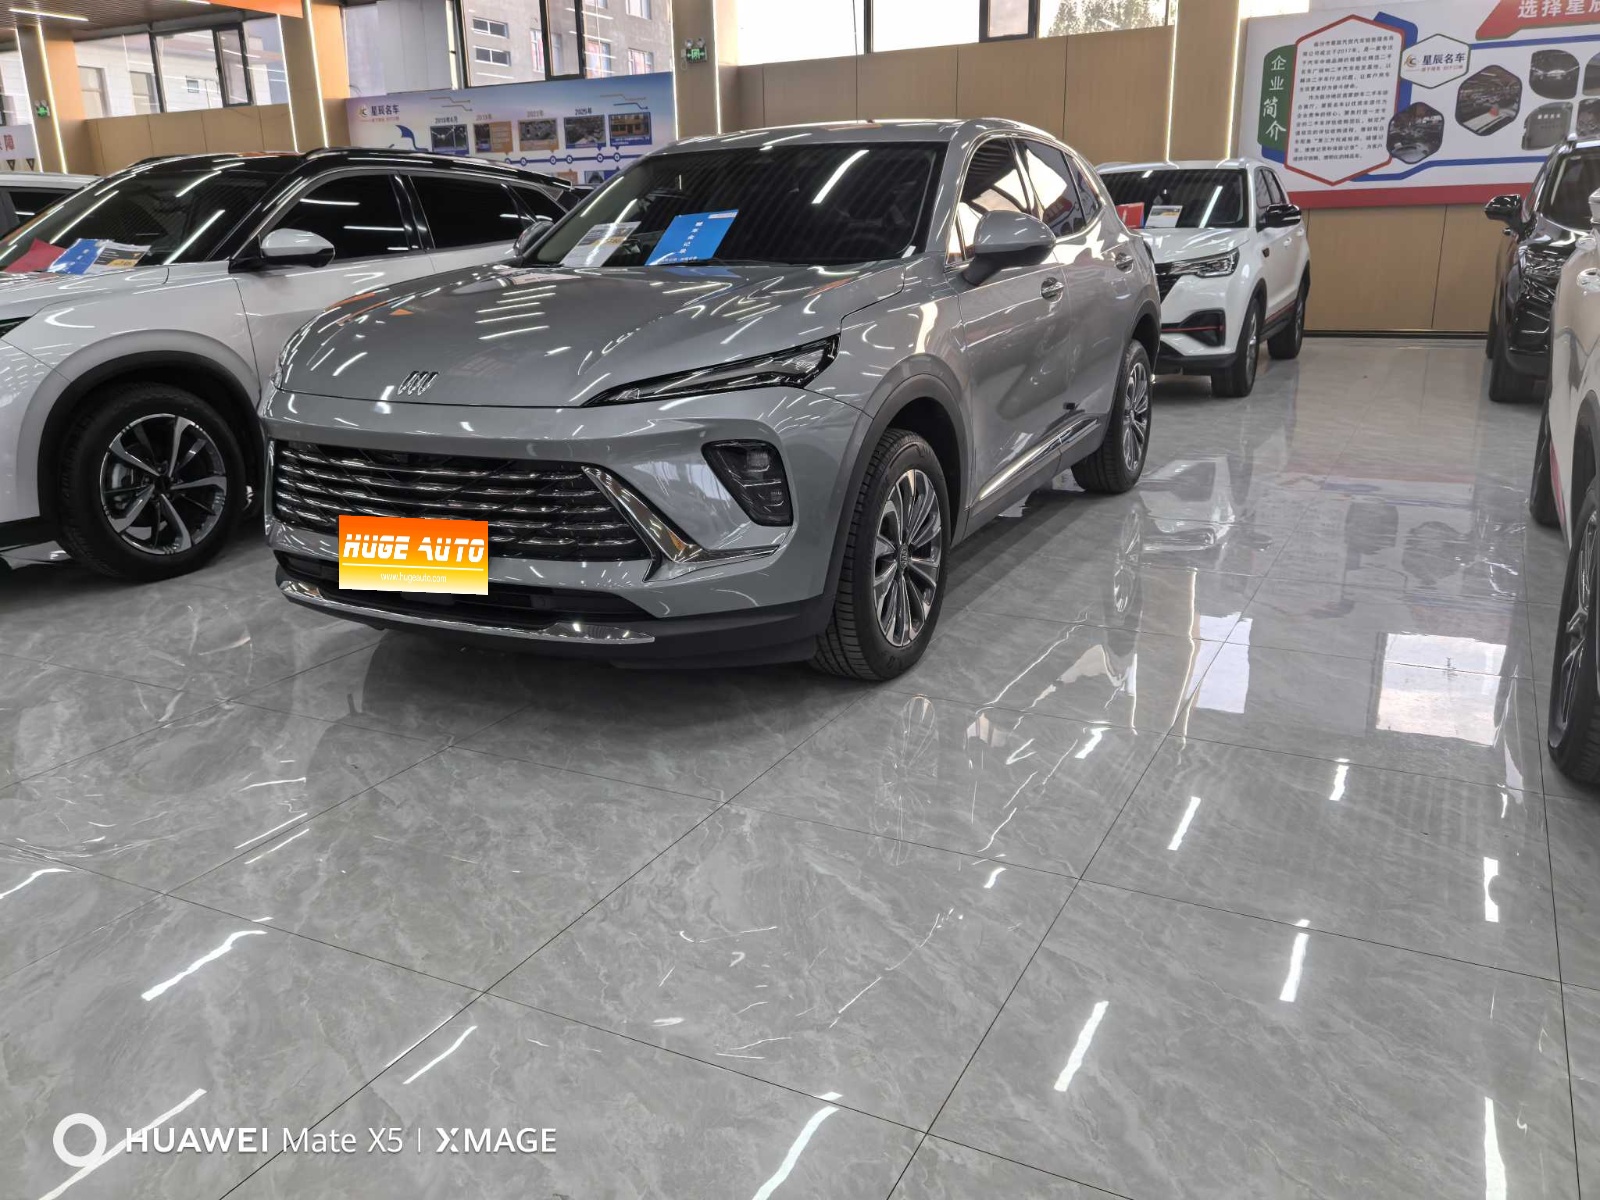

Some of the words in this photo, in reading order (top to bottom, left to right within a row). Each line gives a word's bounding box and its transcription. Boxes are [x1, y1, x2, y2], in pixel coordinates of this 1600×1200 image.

[1422, 53, 1466, 65] 星辰名车
[1263, 55, 1287, 141] 企业简介
